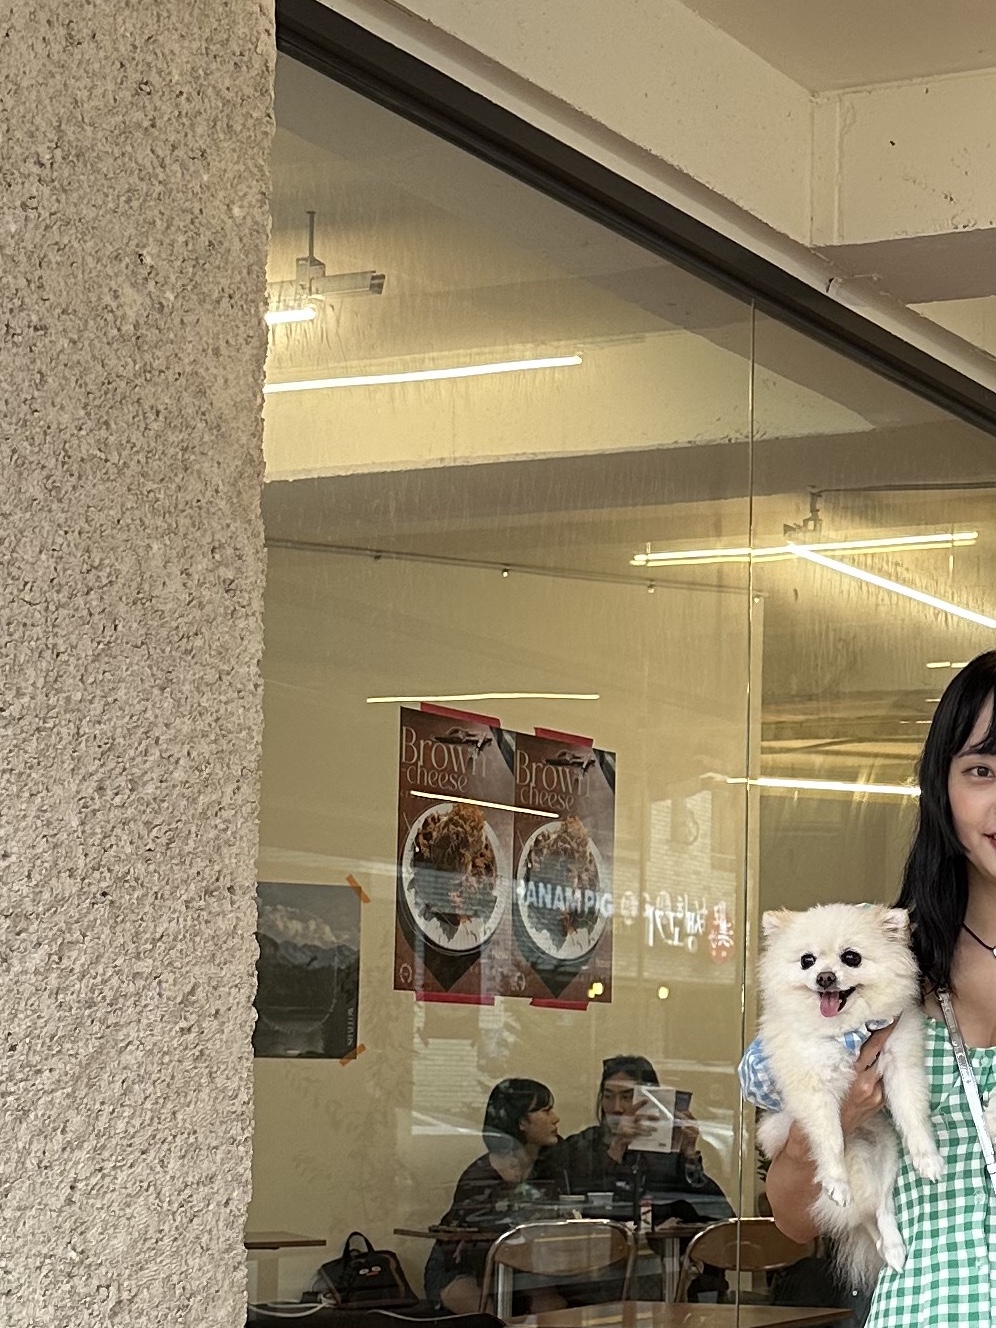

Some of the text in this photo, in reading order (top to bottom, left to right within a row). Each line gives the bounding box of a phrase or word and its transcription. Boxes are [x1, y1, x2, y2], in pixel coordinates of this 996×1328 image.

[402, 725, 487, 778] Brown
[406, 761, 468, 793] cheese
[516, 750, 590, 798] Brown
[520, 783, 575, 812] cheese
